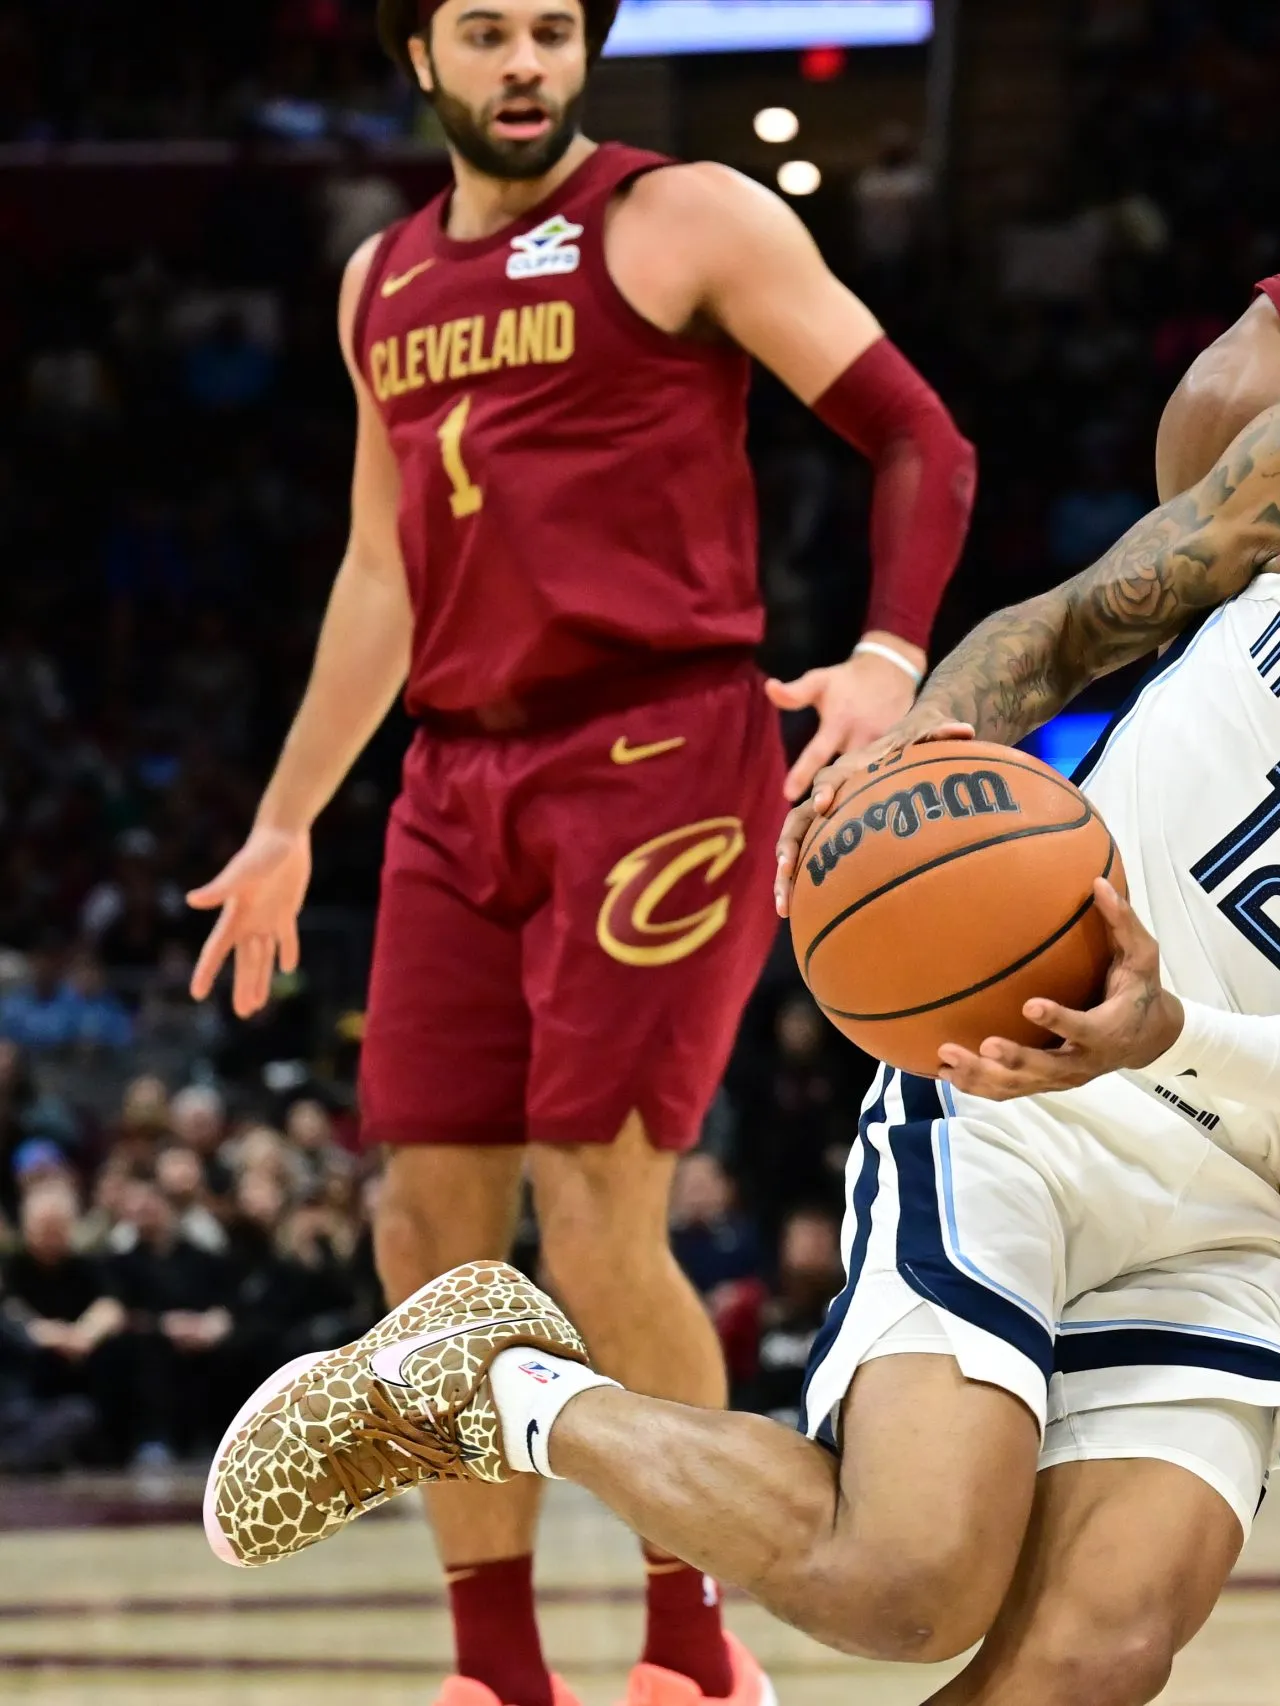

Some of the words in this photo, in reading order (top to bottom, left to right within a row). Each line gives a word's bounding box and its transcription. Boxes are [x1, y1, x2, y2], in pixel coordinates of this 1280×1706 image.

[370, 301, 575, 402] CLEVELAND
[437, 394, 482, 519] 1
[806, 770, 1022, 887] Wilson
